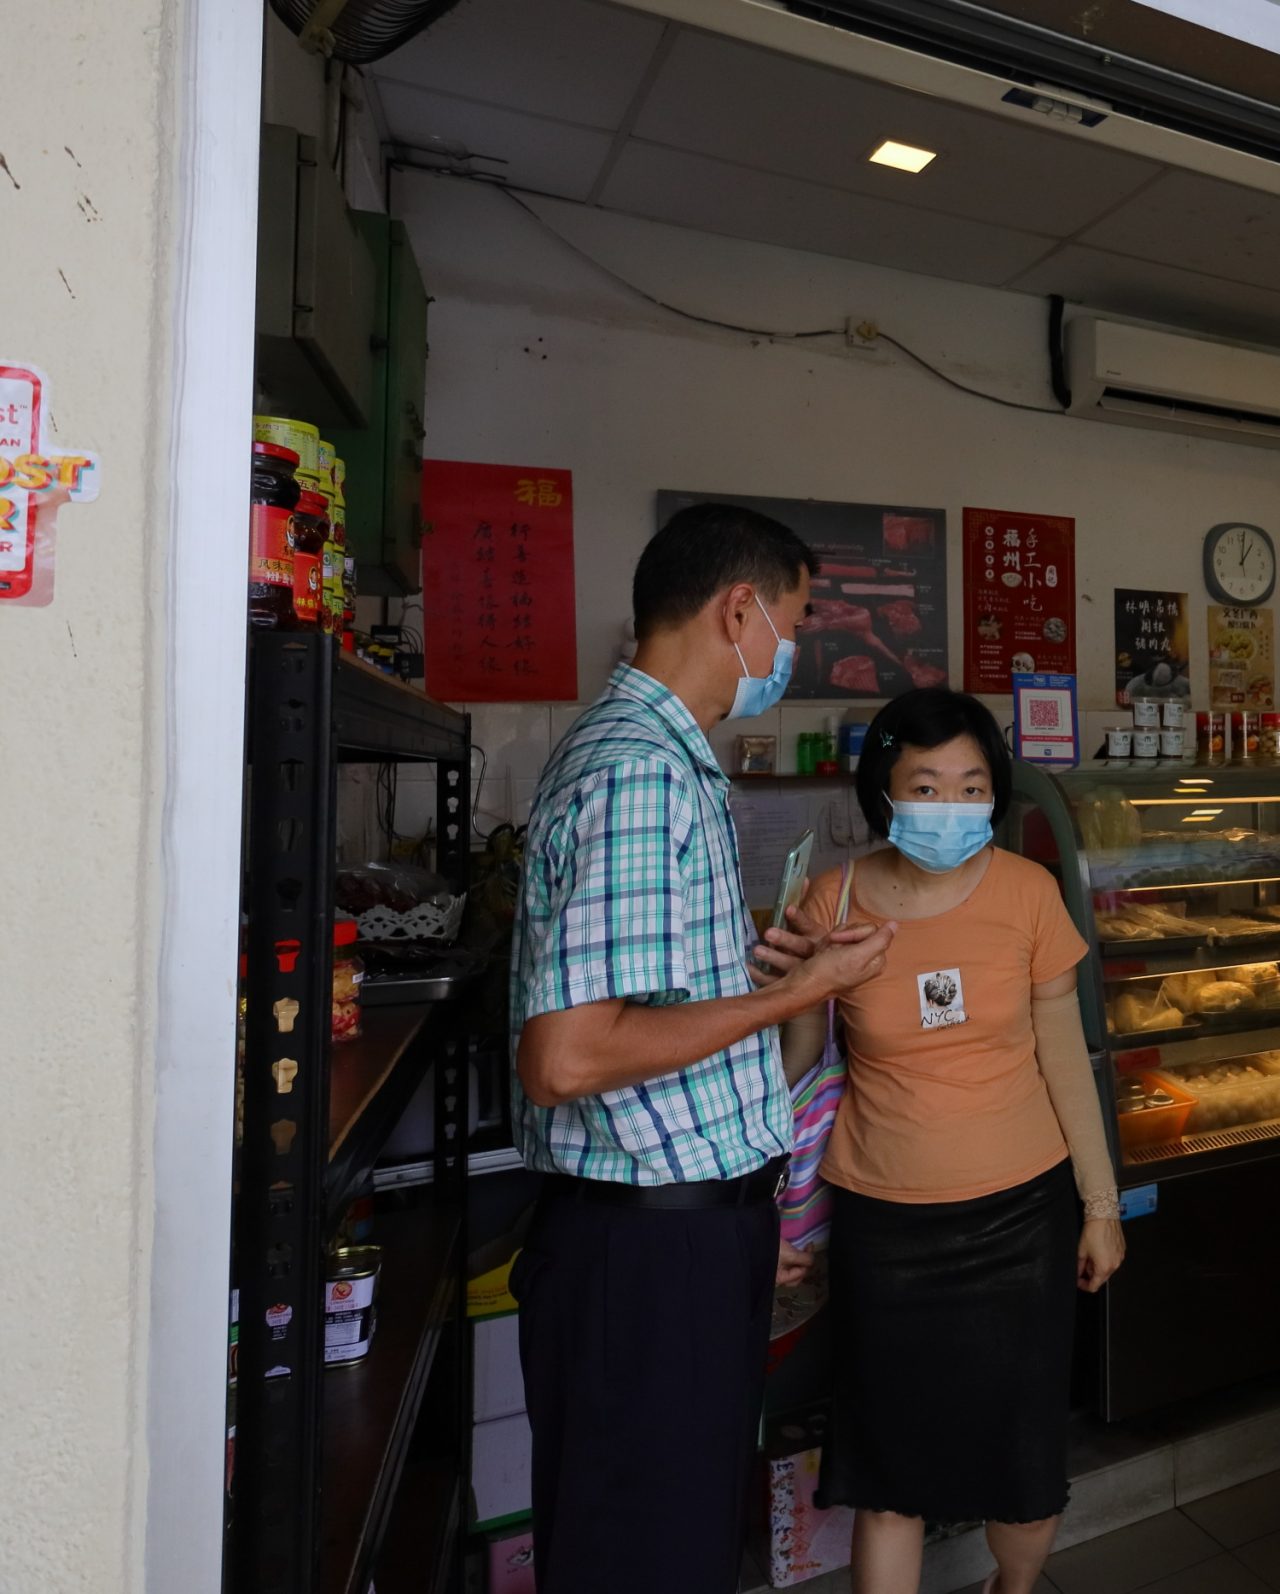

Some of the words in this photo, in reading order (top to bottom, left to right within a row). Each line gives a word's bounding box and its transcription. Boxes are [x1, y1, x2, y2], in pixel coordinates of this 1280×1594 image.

[514, 477, 563, 508] 福
[1002, 529, 1021, 572] 福州
[1023, 527, 1043, 612] 手工小吃
[920, 1009, 954, 1026] NYC
